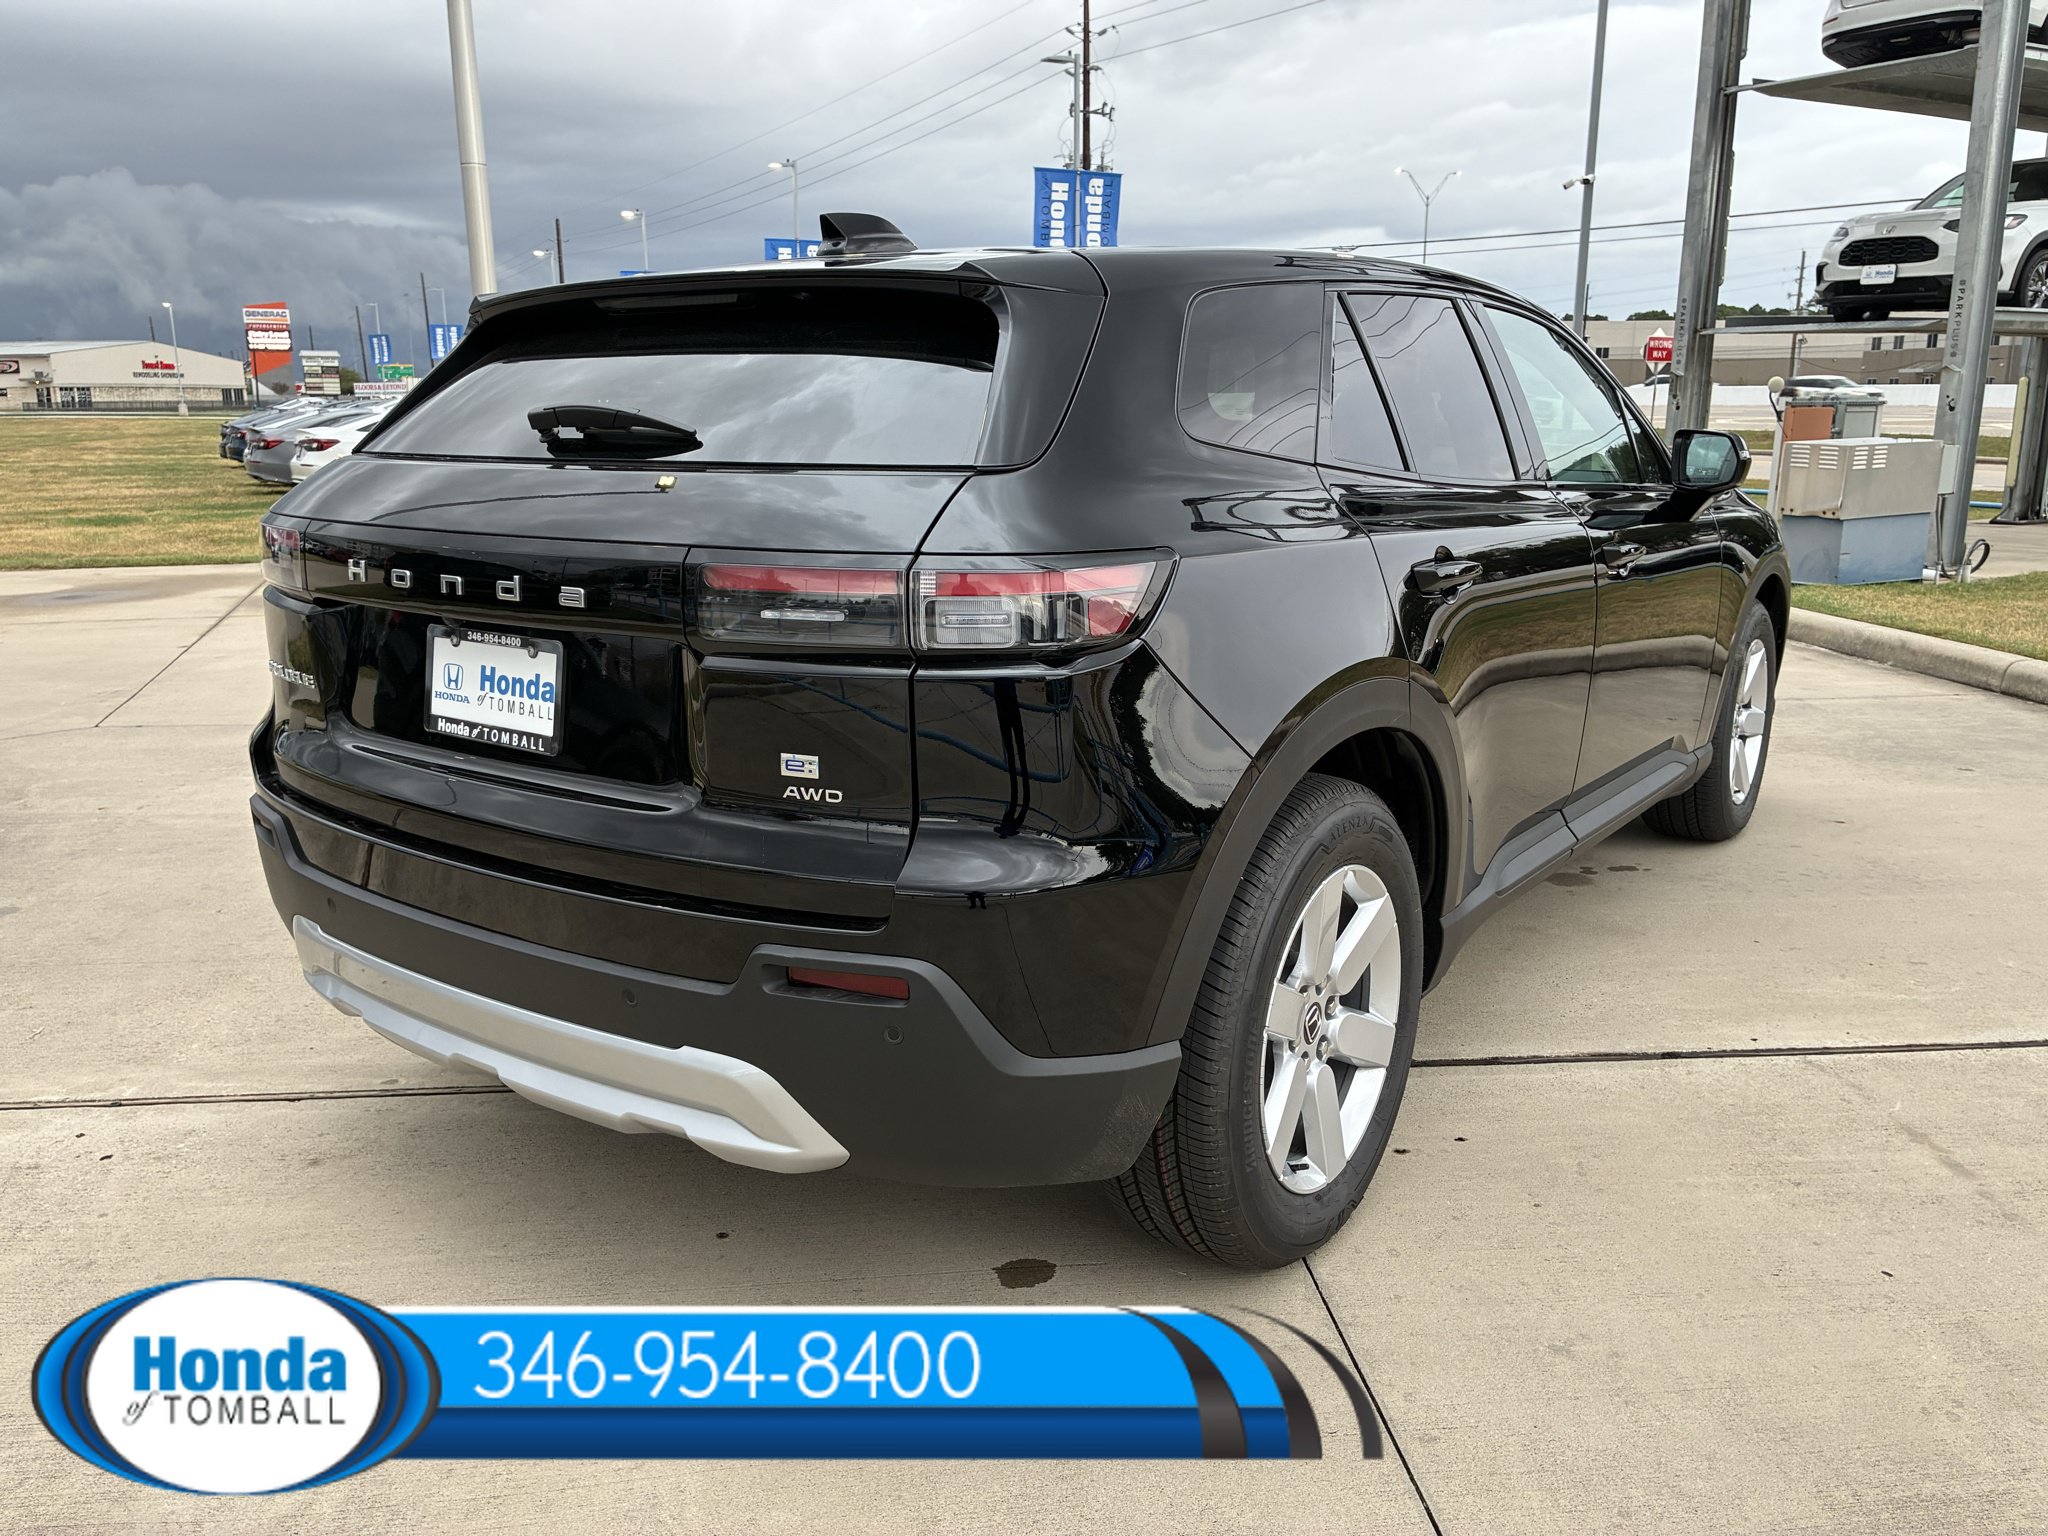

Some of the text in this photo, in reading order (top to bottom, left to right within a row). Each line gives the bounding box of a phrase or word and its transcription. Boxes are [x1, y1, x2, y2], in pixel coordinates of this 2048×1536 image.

[1041, 195, 1051, 247] TOMB
[1085, 178, 1104, 247] onda
[1101, 180, 1114, 246] OMBALL
[1649, 340, 1673, 349] WRONG
[1652, 350, 1668, 358] WAY
[347, 558, 586, 609] Honda
[466, 631, 522, 647] 346-954-8400
[434, 690, 471, 704] HONDA
[479, 664, 556, 703] Honda
[476, 692, 553, 721] of TOMBALL
[438, 718, 545, 752] Honda of TOMBALL
[783, 785, 843, 803] AWD
